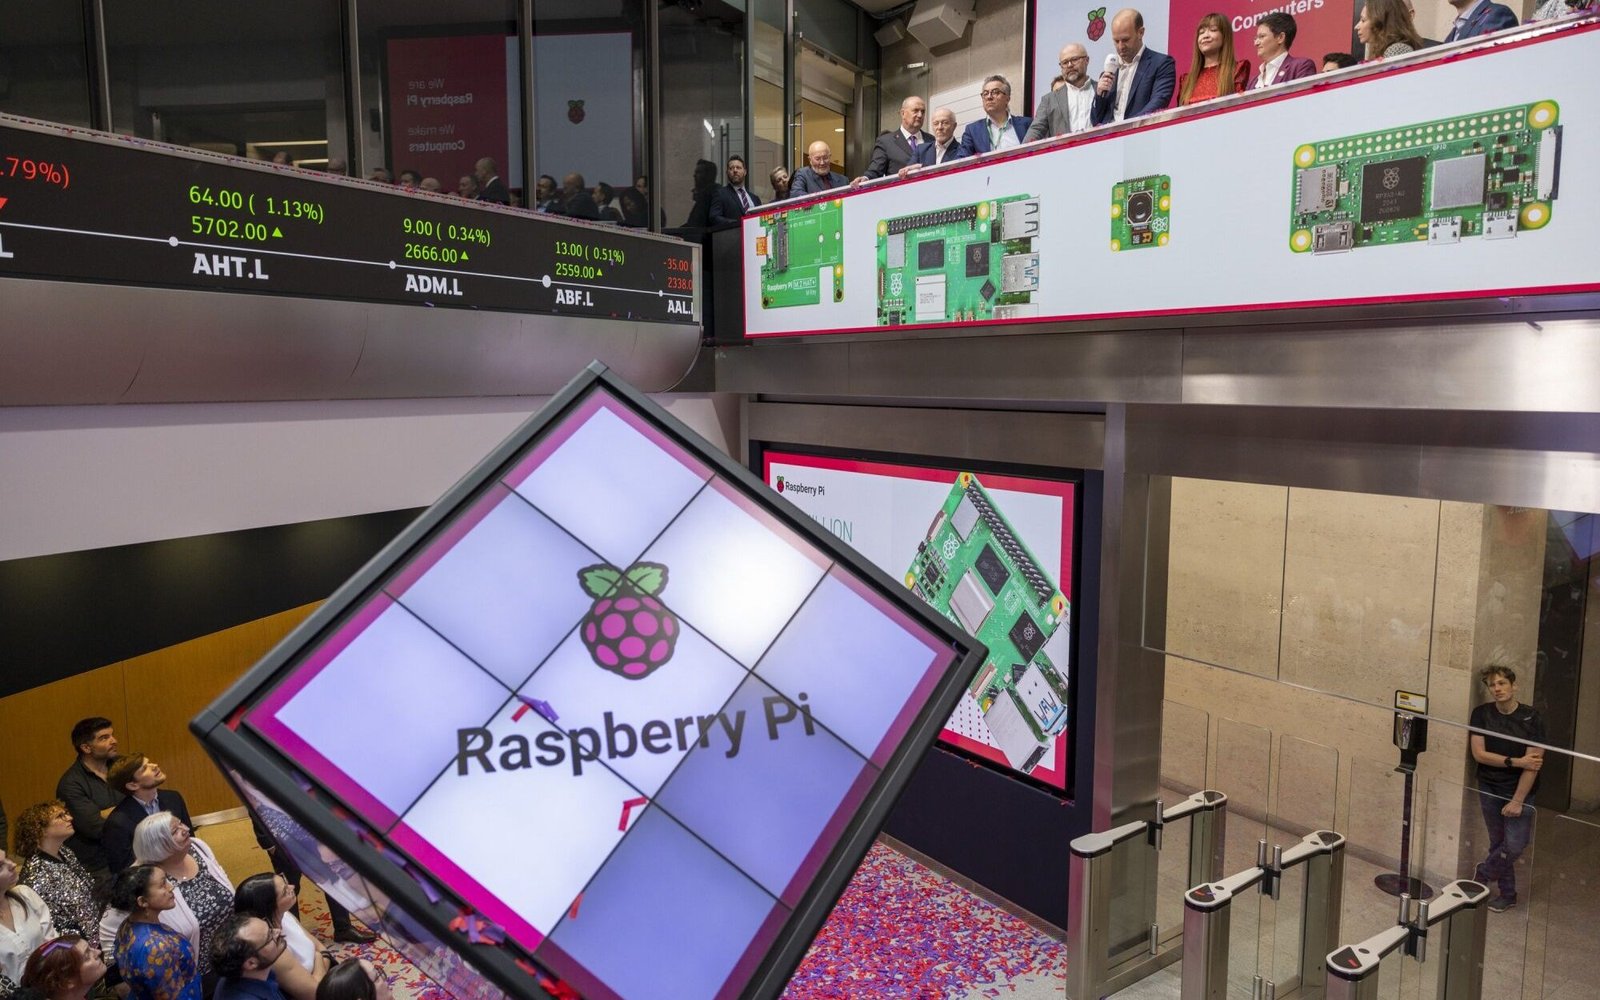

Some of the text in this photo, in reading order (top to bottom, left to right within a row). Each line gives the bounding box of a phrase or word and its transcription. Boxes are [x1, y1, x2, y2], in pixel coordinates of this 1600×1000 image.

[189, 186, 243, 209] 64.00
[192, 215, 267, 241] 5702.00
[403, 218, 433, 236] 9.00
[405, 243, 458, 263] 2666.00
[555, 241, 583, 257] 13.00
[192, 252, 269, 280] AHT.L
[555, 262, 595, 279] 2559.00
[405, 273, 463, 296] ADM.L
[555, 288, 594, 307] ABF.L
[784, 481, 825, 497] Raspberry Pi
[456, 692, 815, 777] Raspberry Pi
